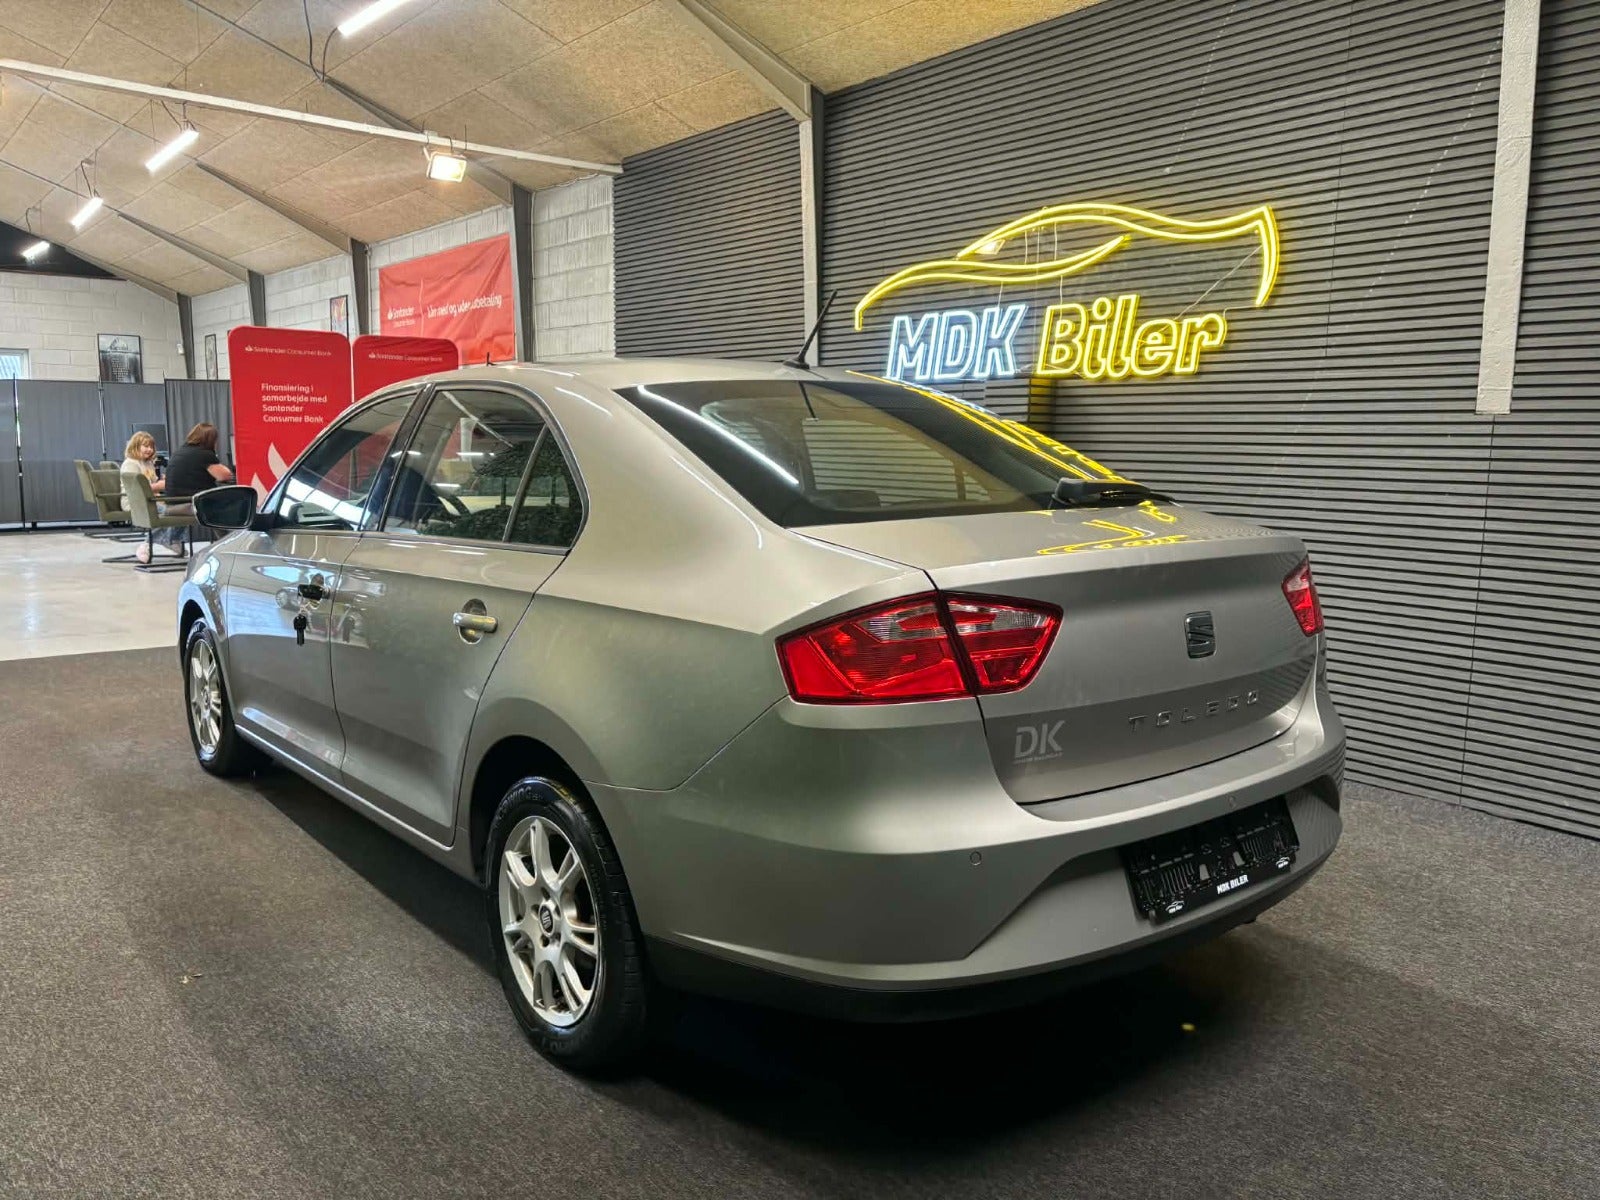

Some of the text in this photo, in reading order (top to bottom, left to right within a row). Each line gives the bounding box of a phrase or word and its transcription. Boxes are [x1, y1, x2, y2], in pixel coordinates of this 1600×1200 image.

[886, 294, 1228, 381] MDK Biler
[253, 346, 286, 354] Santander
[261, 383, 310, 394] Finansiering
[261, 394, 327, 404] samarbejde med
[262, 404, 303, 412] Santander
[263, 414, 324, 423] Consumer Bank
[1128, 690, 1259, 733] TOLEDO
[1014, 720, 1065, 758] DK
[1230, 874, 1249, 889] BILER
